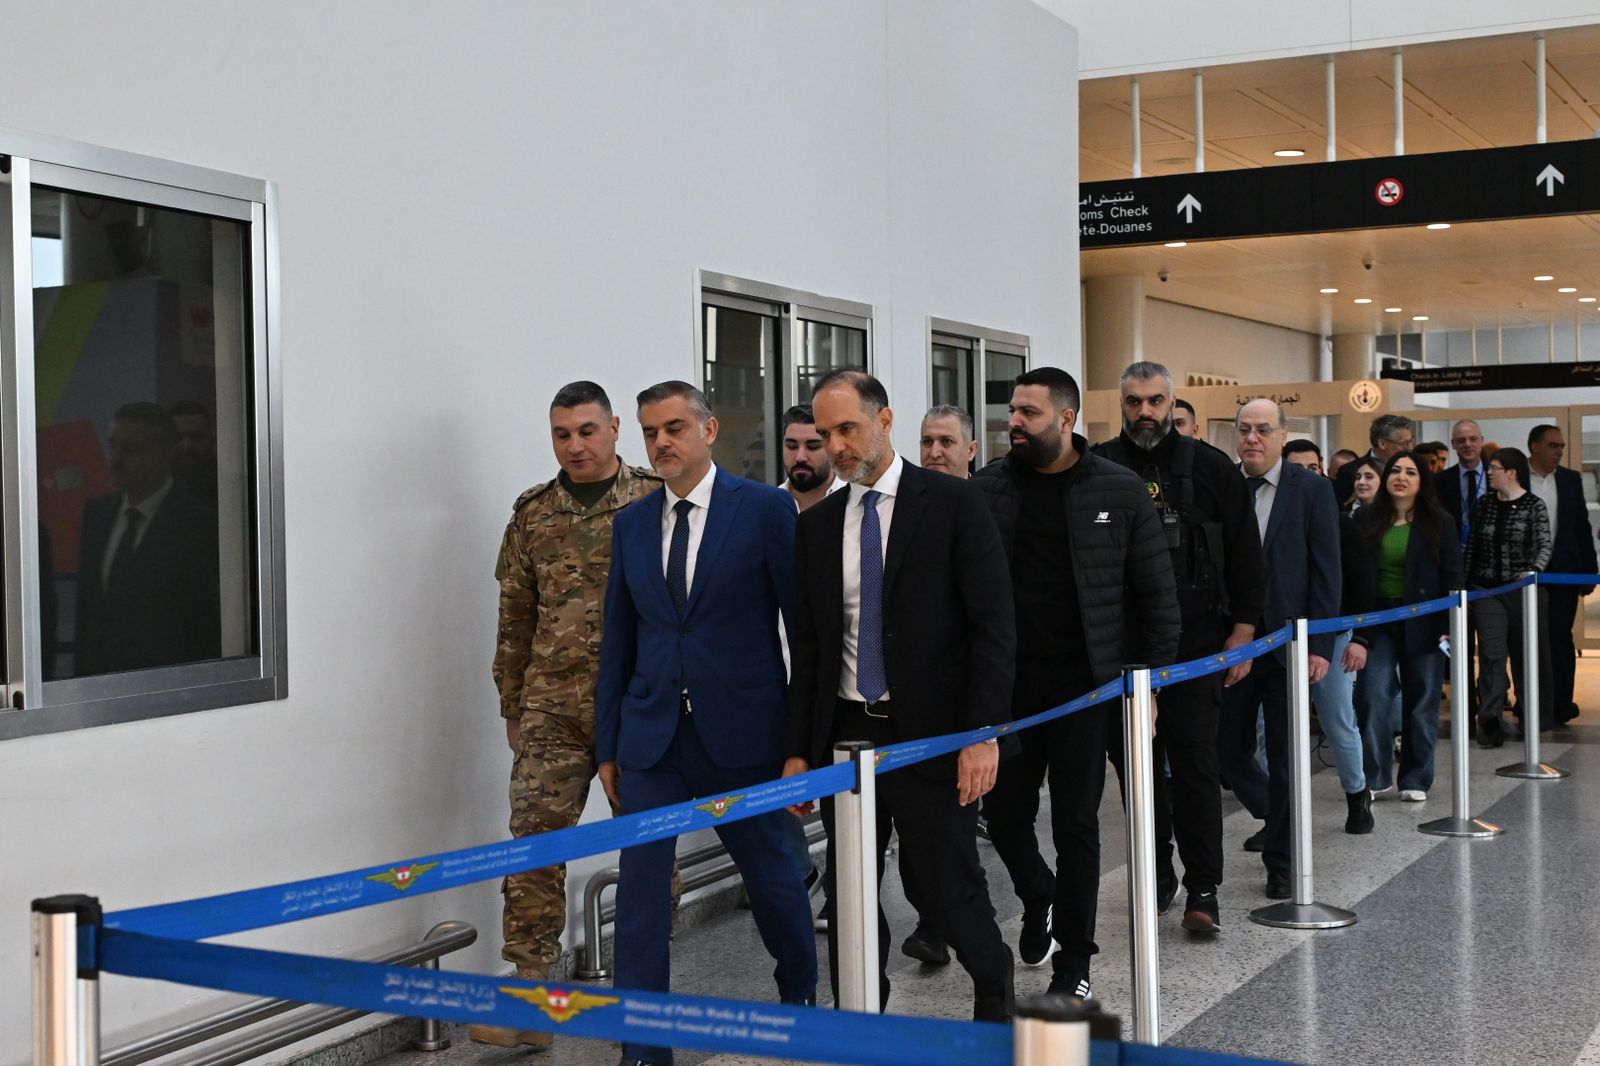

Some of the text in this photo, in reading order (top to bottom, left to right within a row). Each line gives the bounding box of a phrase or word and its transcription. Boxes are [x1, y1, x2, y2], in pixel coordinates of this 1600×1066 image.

[1094, 191, 1135, 207] تفتيش
[1080, 205, 1149, 220] oms Check
[1079, 222, 1153, 236] té-Douanes
